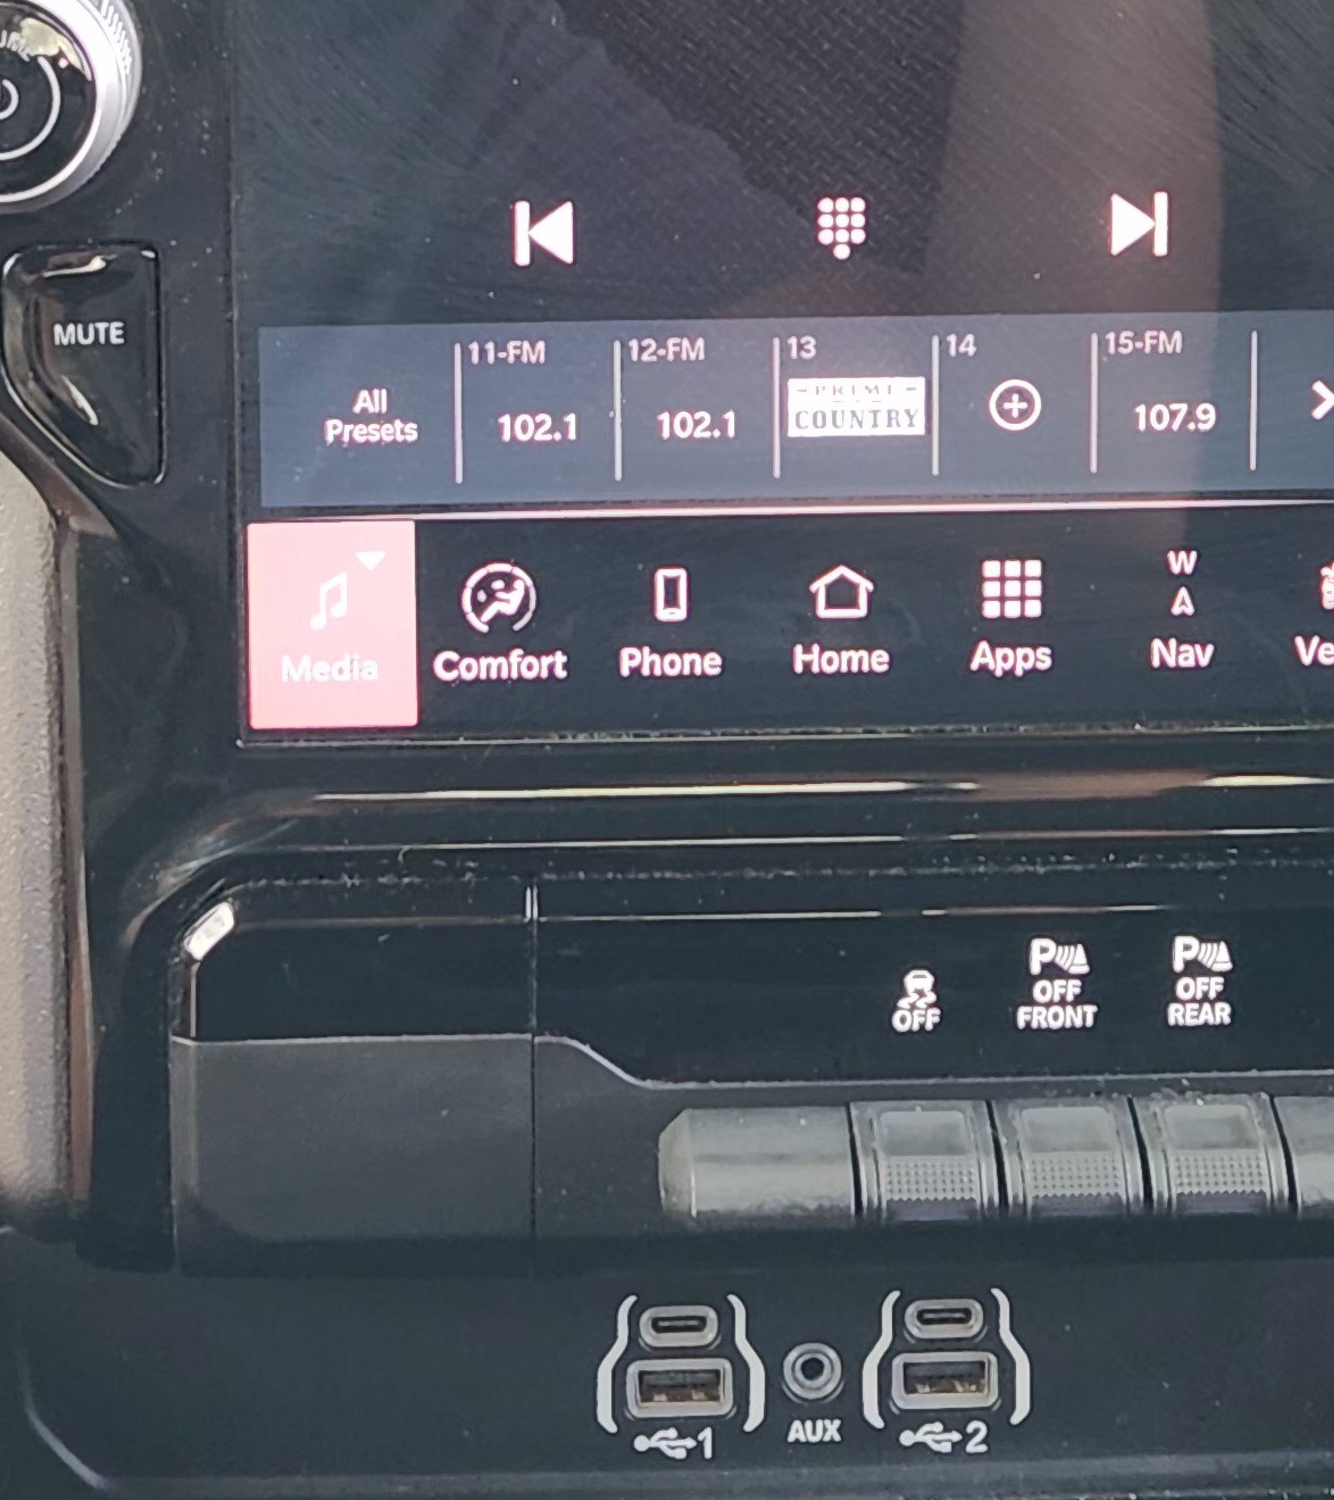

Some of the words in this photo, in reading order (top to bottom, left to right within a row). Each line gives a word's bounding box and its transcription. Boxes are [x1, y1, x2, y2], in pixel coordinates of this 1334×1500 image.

[53, 321, 125, 346] MUTE
[946, 334, 976, 357] 14
[1105, 331, 1182, 355] 15-FM
[468, 341, 546, 364] 11-FM
[628, 338, 705, 361] 12-FM
[787, 336, 816, 359] 13
[353, 388, 387, 413] All
[497, 413, 577, 442] 102.1
[657, 411, 736, 439] 102.1
[795, 409, 918, 429] COUNTRY
[1134, 403, 1216, 432] 107.9
[324, 418, 419, 443] Presets
[1167, 550, 1197, 575] W
[433, 648, 567, 682] Comfort
[619, 646, 723, 677] Phone
[793, 643, 890, 674] Home
[971, 641, 1052, 677] Apps
[1150, 638, 1214, 668] Nav
[281, 653, 379, 682] Media
[1032, 979, 1082, 1003] OFF
[1176, 977, 1224, 1000] OFF
[891, 1008, 941, 1032] OFF
[1016, 1005, 1098, 1030] FRONT
[1167, 1002, 1231, 1027] REAR
[697, 1427, 713, 1459] 1
[787, 1419, 842, 1443] AUX
[965, 1421, 988, 1453] 2
